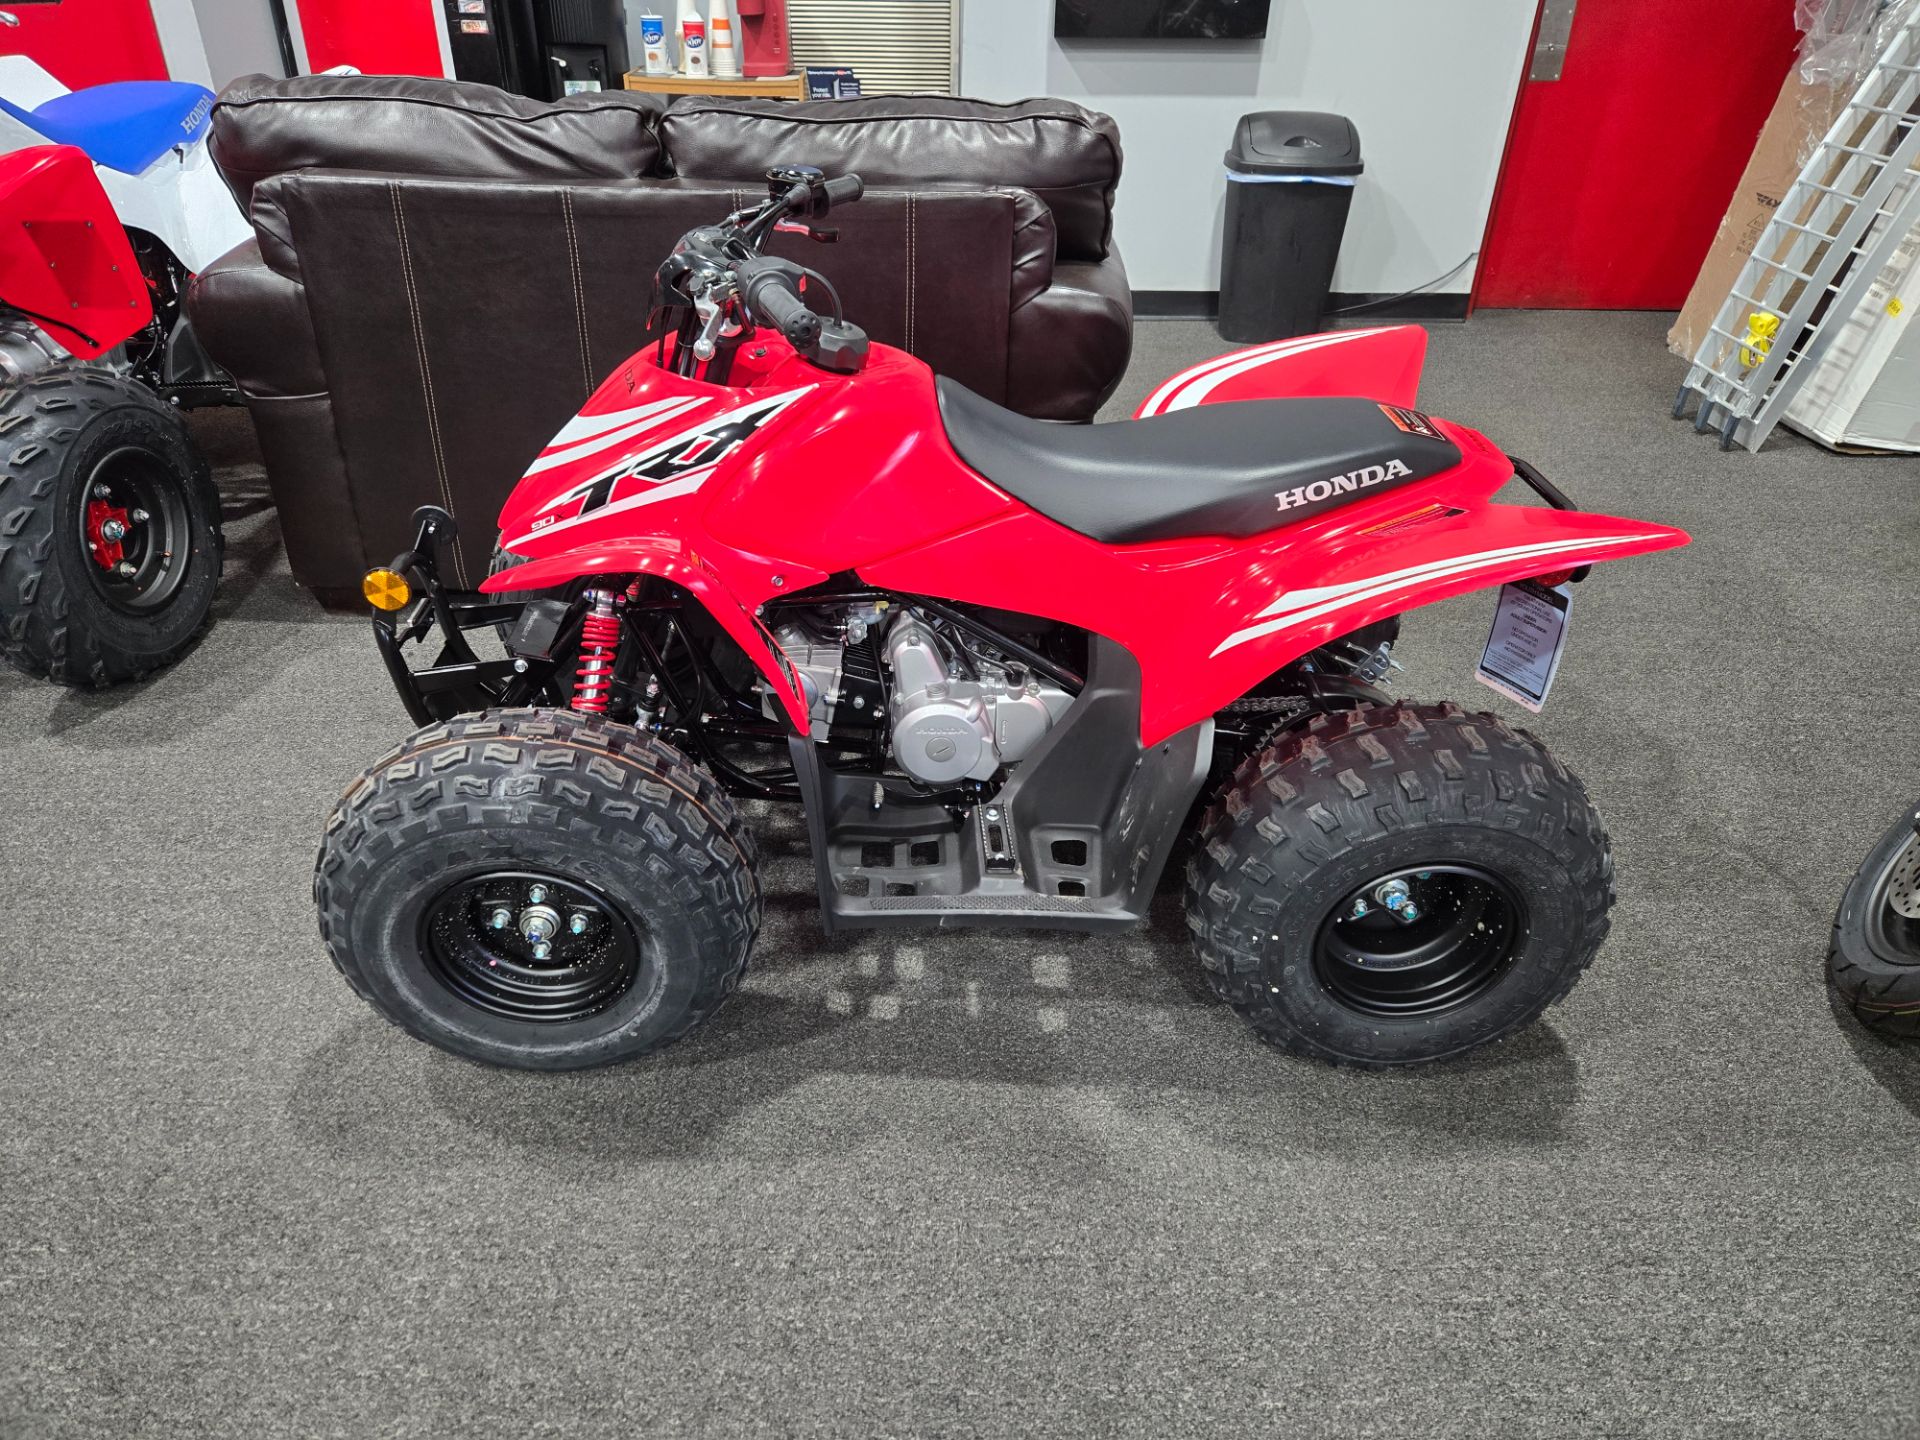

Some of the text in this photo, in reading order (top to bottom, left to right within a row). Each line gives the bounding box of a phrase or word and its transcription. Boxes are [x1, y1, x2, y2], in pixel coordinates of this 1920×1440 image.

[180, 94, 214, 135] HONDA
[564, 399, 789, 518] TRX
[1275, 458, 1413, 511] HONDA
